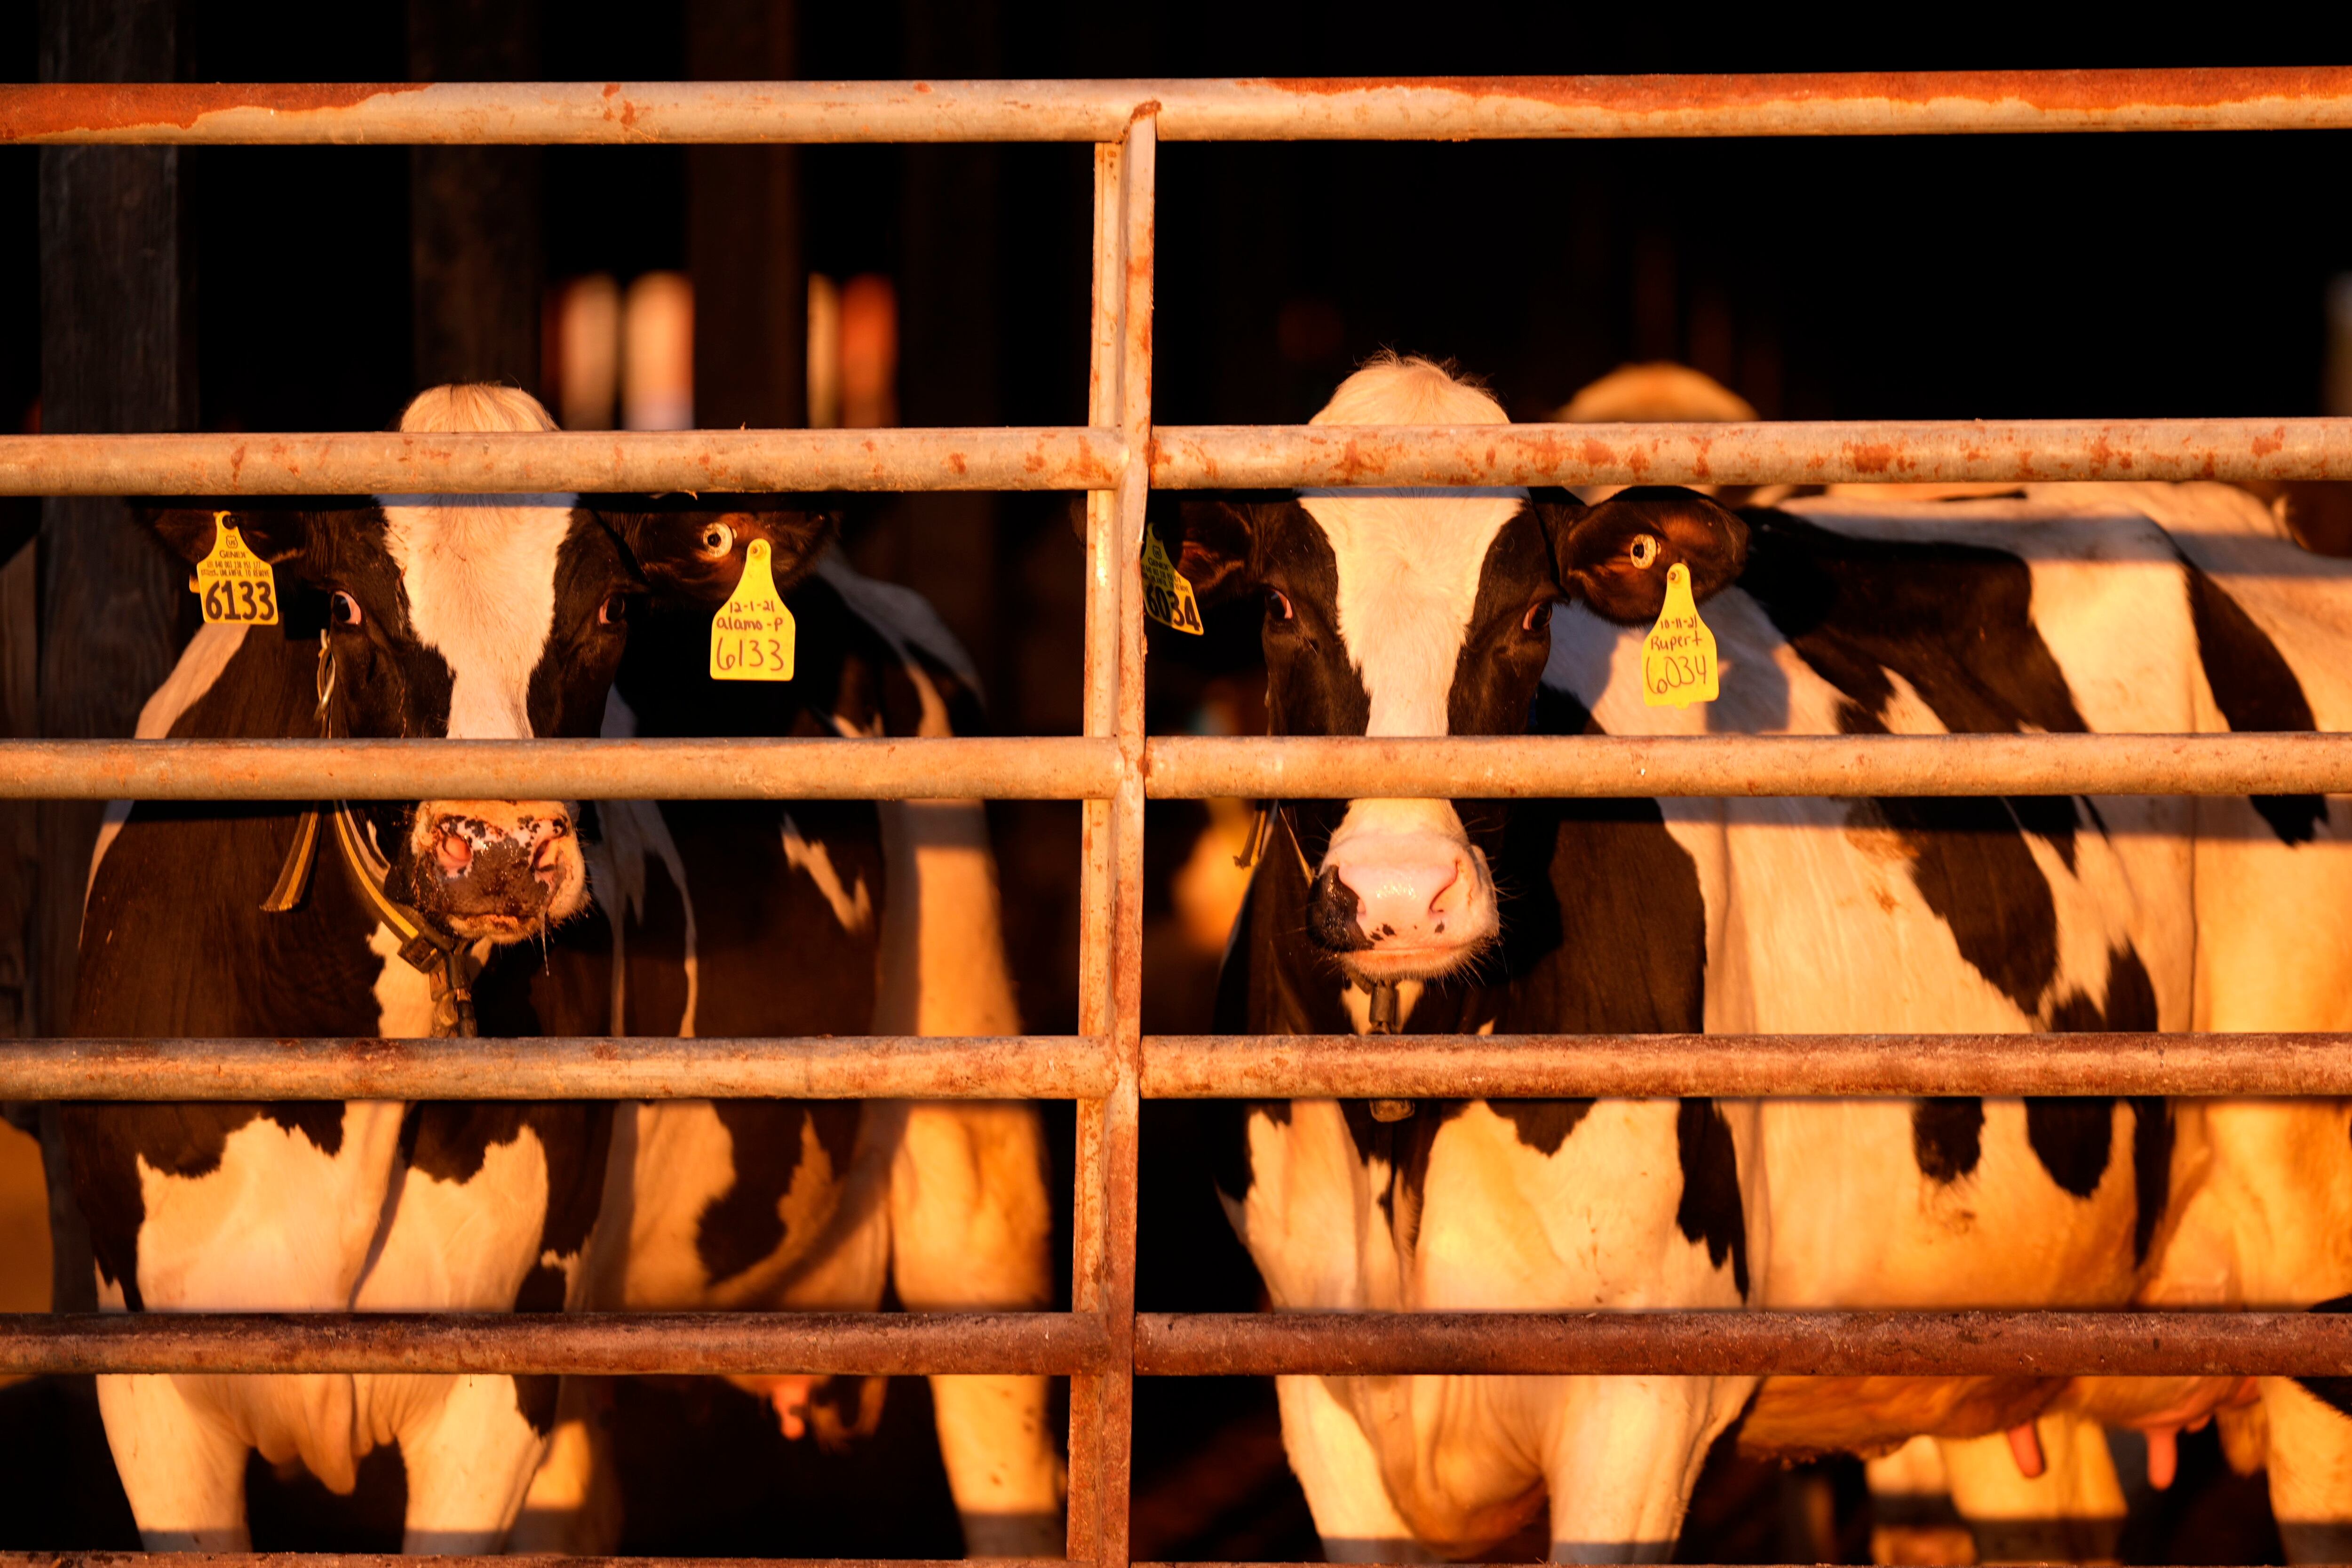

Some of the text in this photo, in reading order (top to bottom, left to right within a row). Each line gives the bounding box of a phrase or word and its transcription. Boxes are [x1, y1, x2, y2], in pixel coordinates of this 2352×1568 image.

[206, 580, 274, 621] 6133
[730, 600, 775, 613] 12-1-21
[1147, 583, 1200, 631] 6034
[716, 637, 784, 671] 6133
[1651, 630, 1702, 651] Rupert
[1646, 655, 1706, 694] 6034
